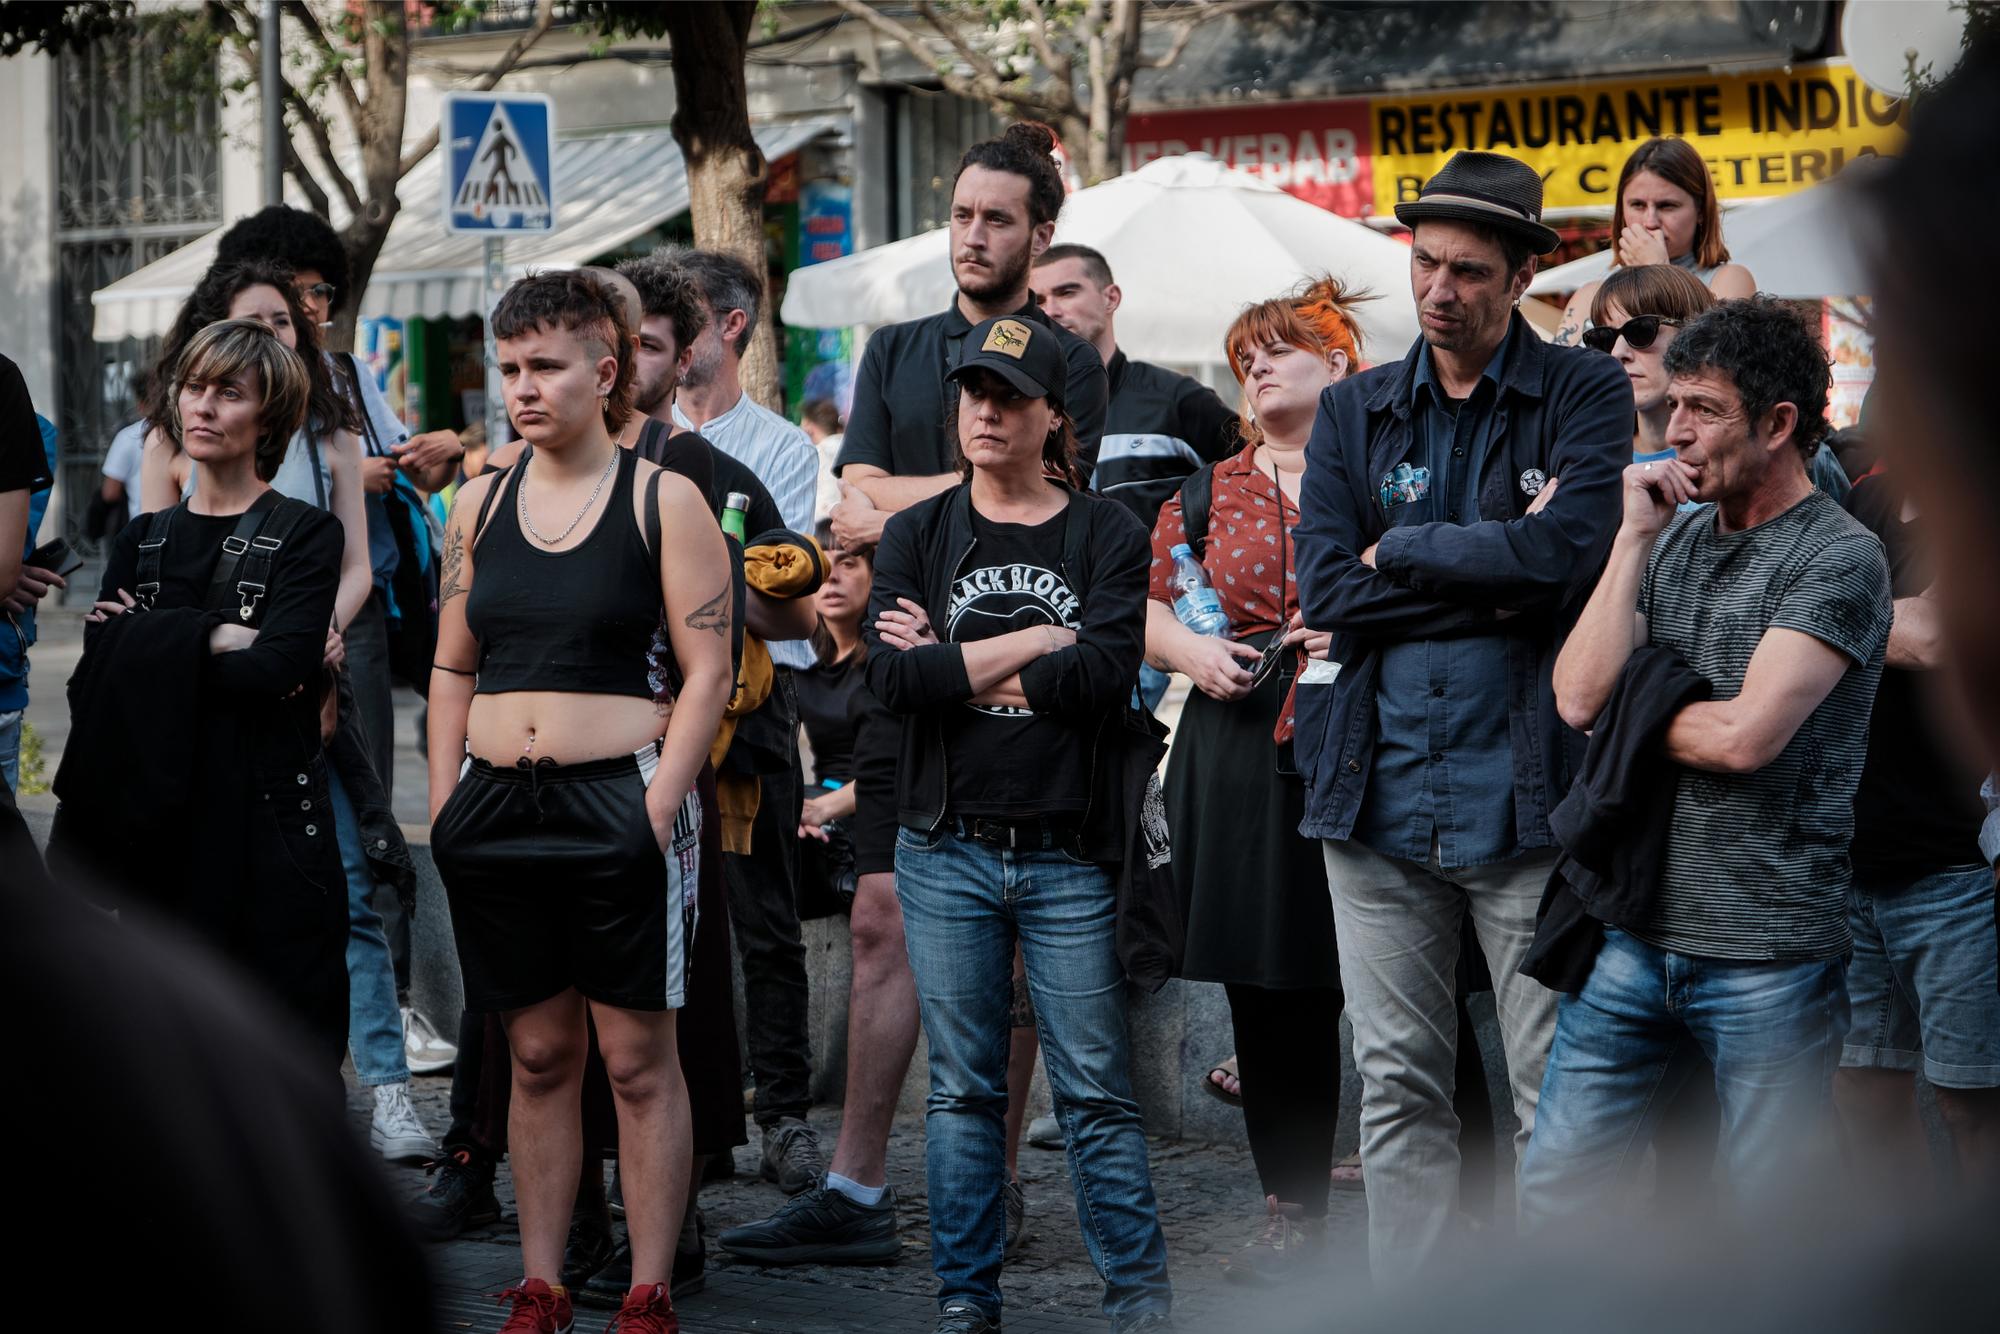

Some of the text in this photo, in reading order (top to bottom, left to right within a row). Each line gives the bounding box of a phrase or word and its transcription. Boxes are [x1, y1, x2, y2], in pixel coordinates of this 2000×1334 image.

[1380, 84, 1721, 155] RESTAURANTE
[1202, 129, 1359, 186] KEBAB
[1011, 566, 1080, 618] BLOCK
